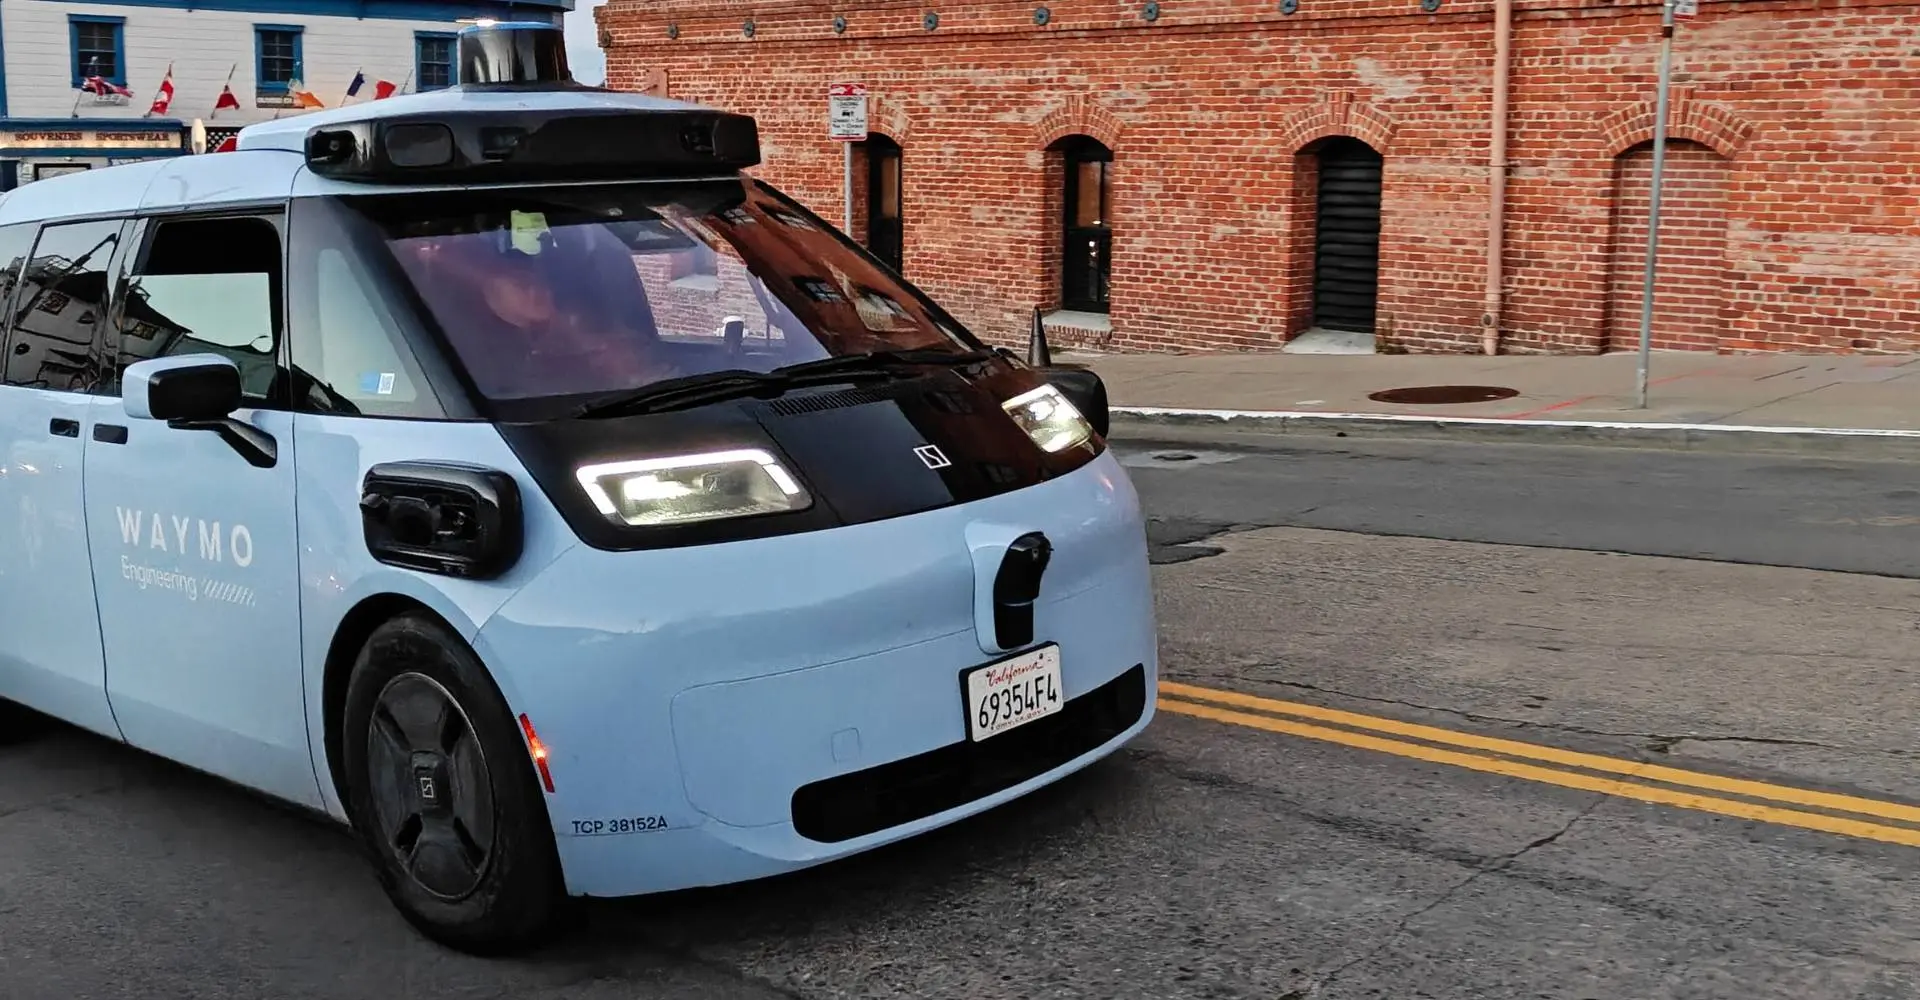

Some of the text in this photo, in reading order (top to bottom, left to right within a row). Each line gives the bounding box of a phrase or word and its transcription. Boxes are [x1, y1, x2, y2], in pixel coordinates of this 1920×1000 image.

[95, 132, 170, 142] SPORTSWEAR
[116, 505, 253, 568] WAYMO
[121, 555, 198, 601] Engineering
[988, 661, 1043, 687] California
[979, 673, 1057, 728] 69354F4
[571, 815, 668, 834] TCP 38152A
